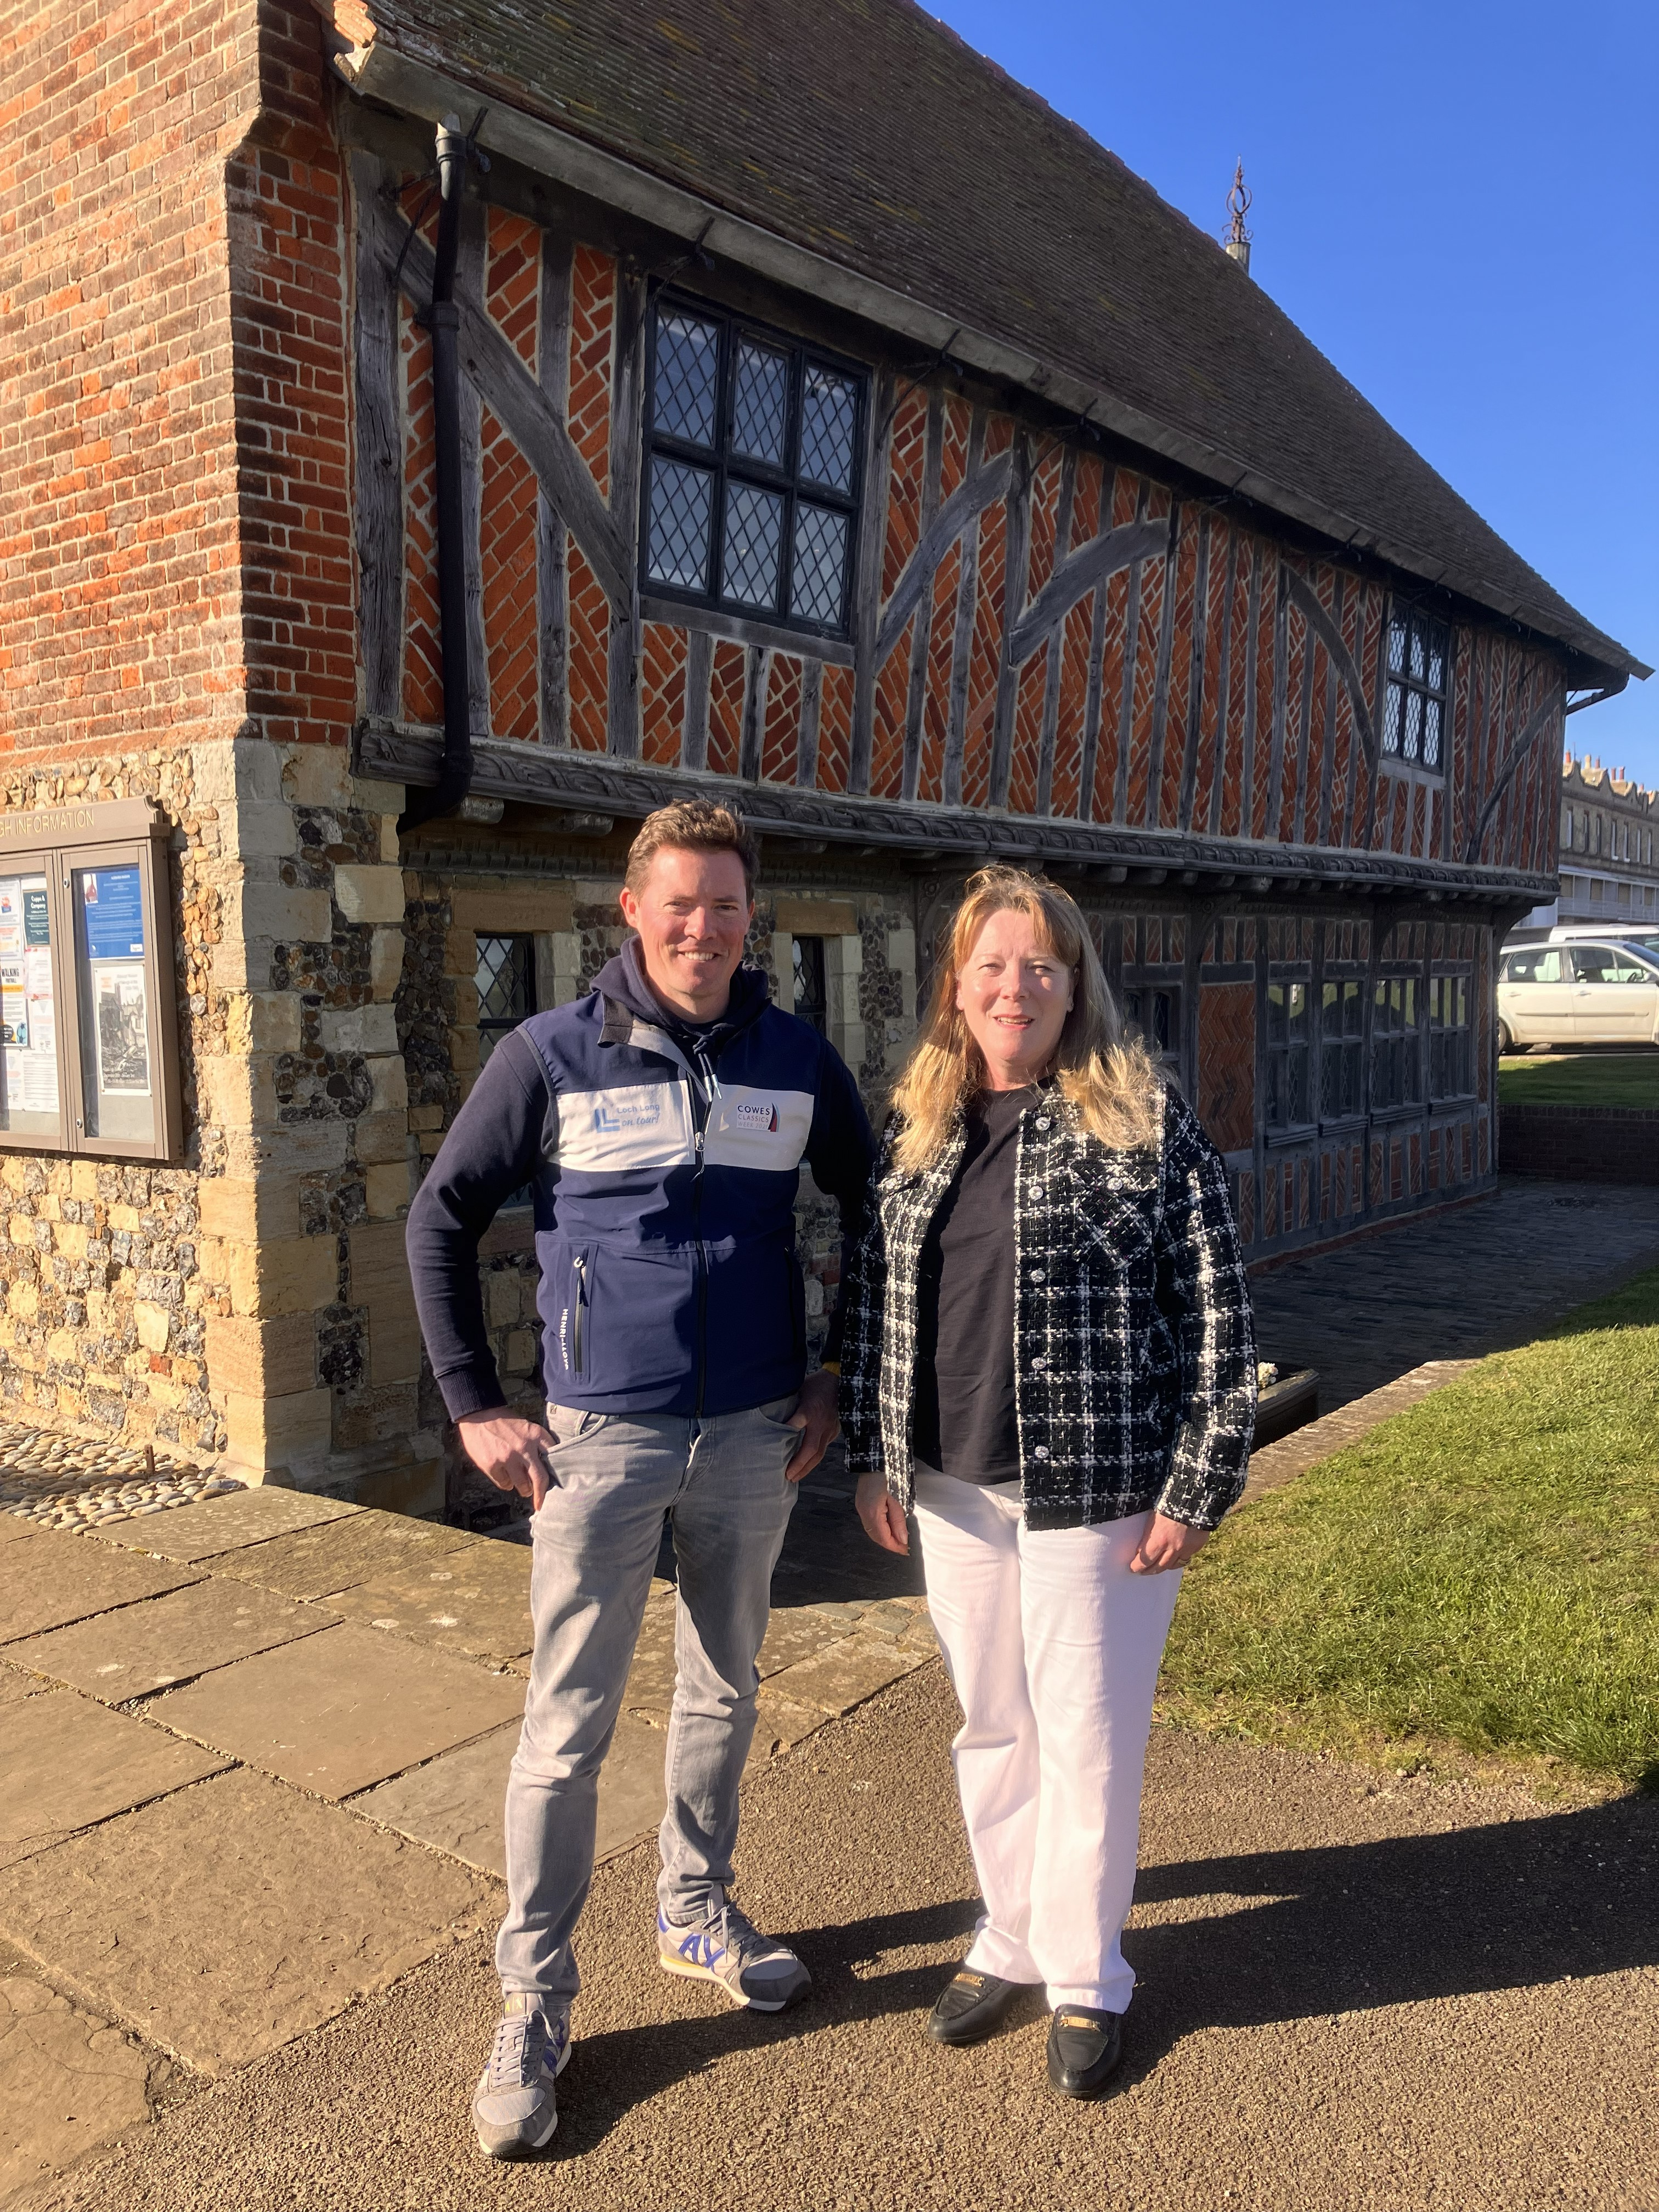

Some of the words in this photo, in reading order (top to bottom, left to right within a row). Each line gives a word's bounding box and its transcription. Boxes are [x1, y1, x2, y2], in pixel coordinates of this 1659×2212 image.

[15, 809, 94, 834] INFORMATION
[617, 1105, 637, 1114] Loch
[737, 1105, 770, 1115] COWES
[636, 1113, 660, 1125] tour!
[738, 1114, 769, 1123] CLASSICS
